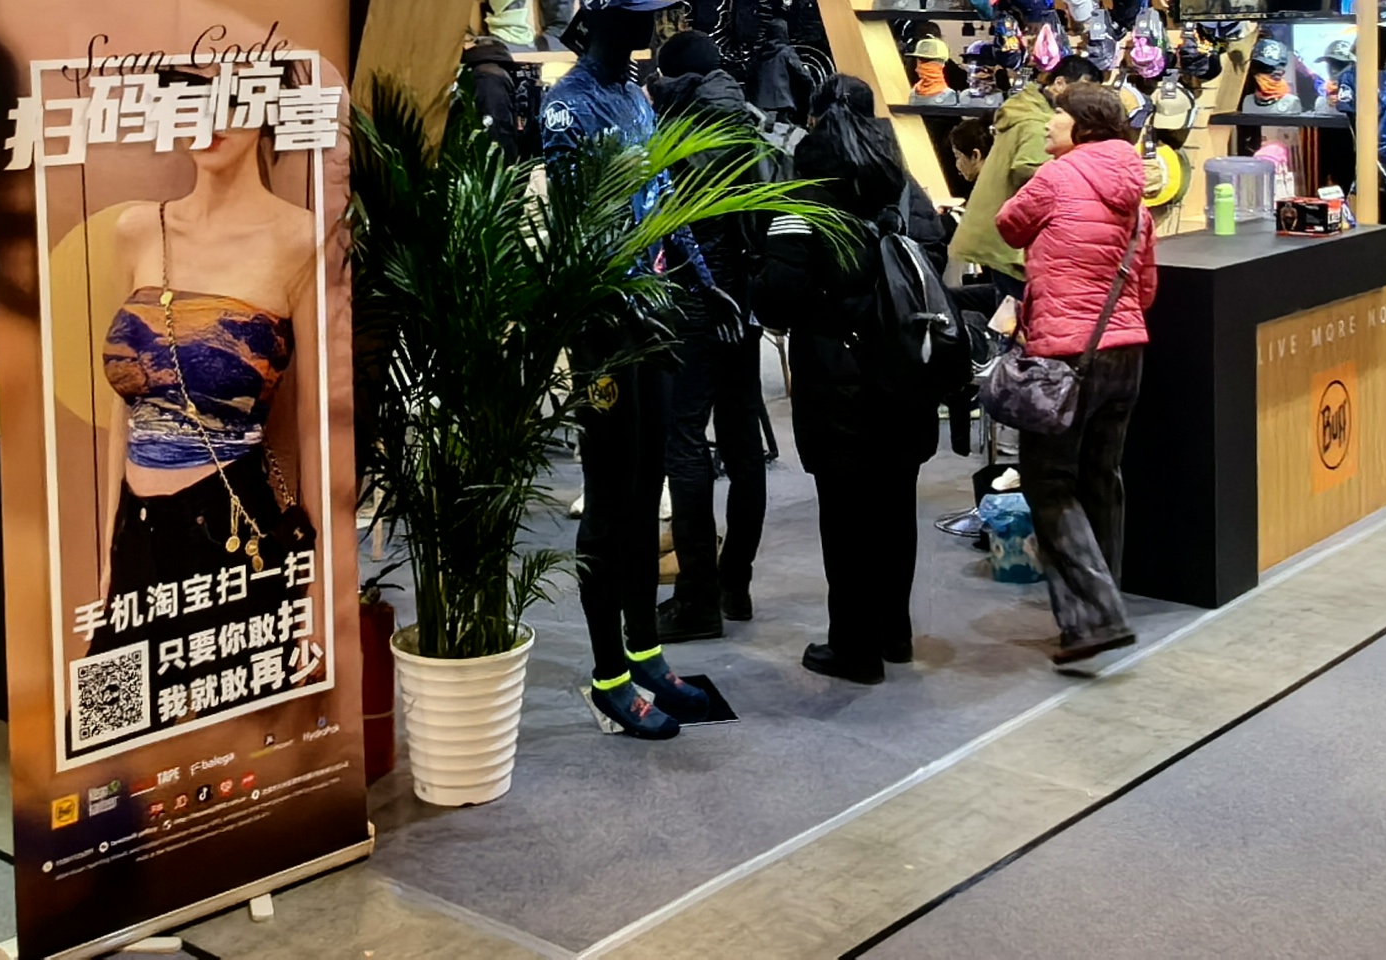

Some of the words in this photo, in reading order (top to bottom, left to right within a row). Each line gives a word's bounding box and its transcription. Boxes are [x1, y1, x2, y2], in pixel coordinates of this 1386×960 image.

[62, 33, 173, 81] Scan
[190, 21, 294, 69] Code
[4, 61, 343, 171] 扫码有惊喜
[1257, 335, 1297, 365] LIVE
[1311, 315, 1357, 348] MORE
[73, 550, 315, 641] 手机淘宝扫一扫
[157, 596, 313, 675] 只要你敢扫
[157, 640, 324, 723] 我就敢再少
